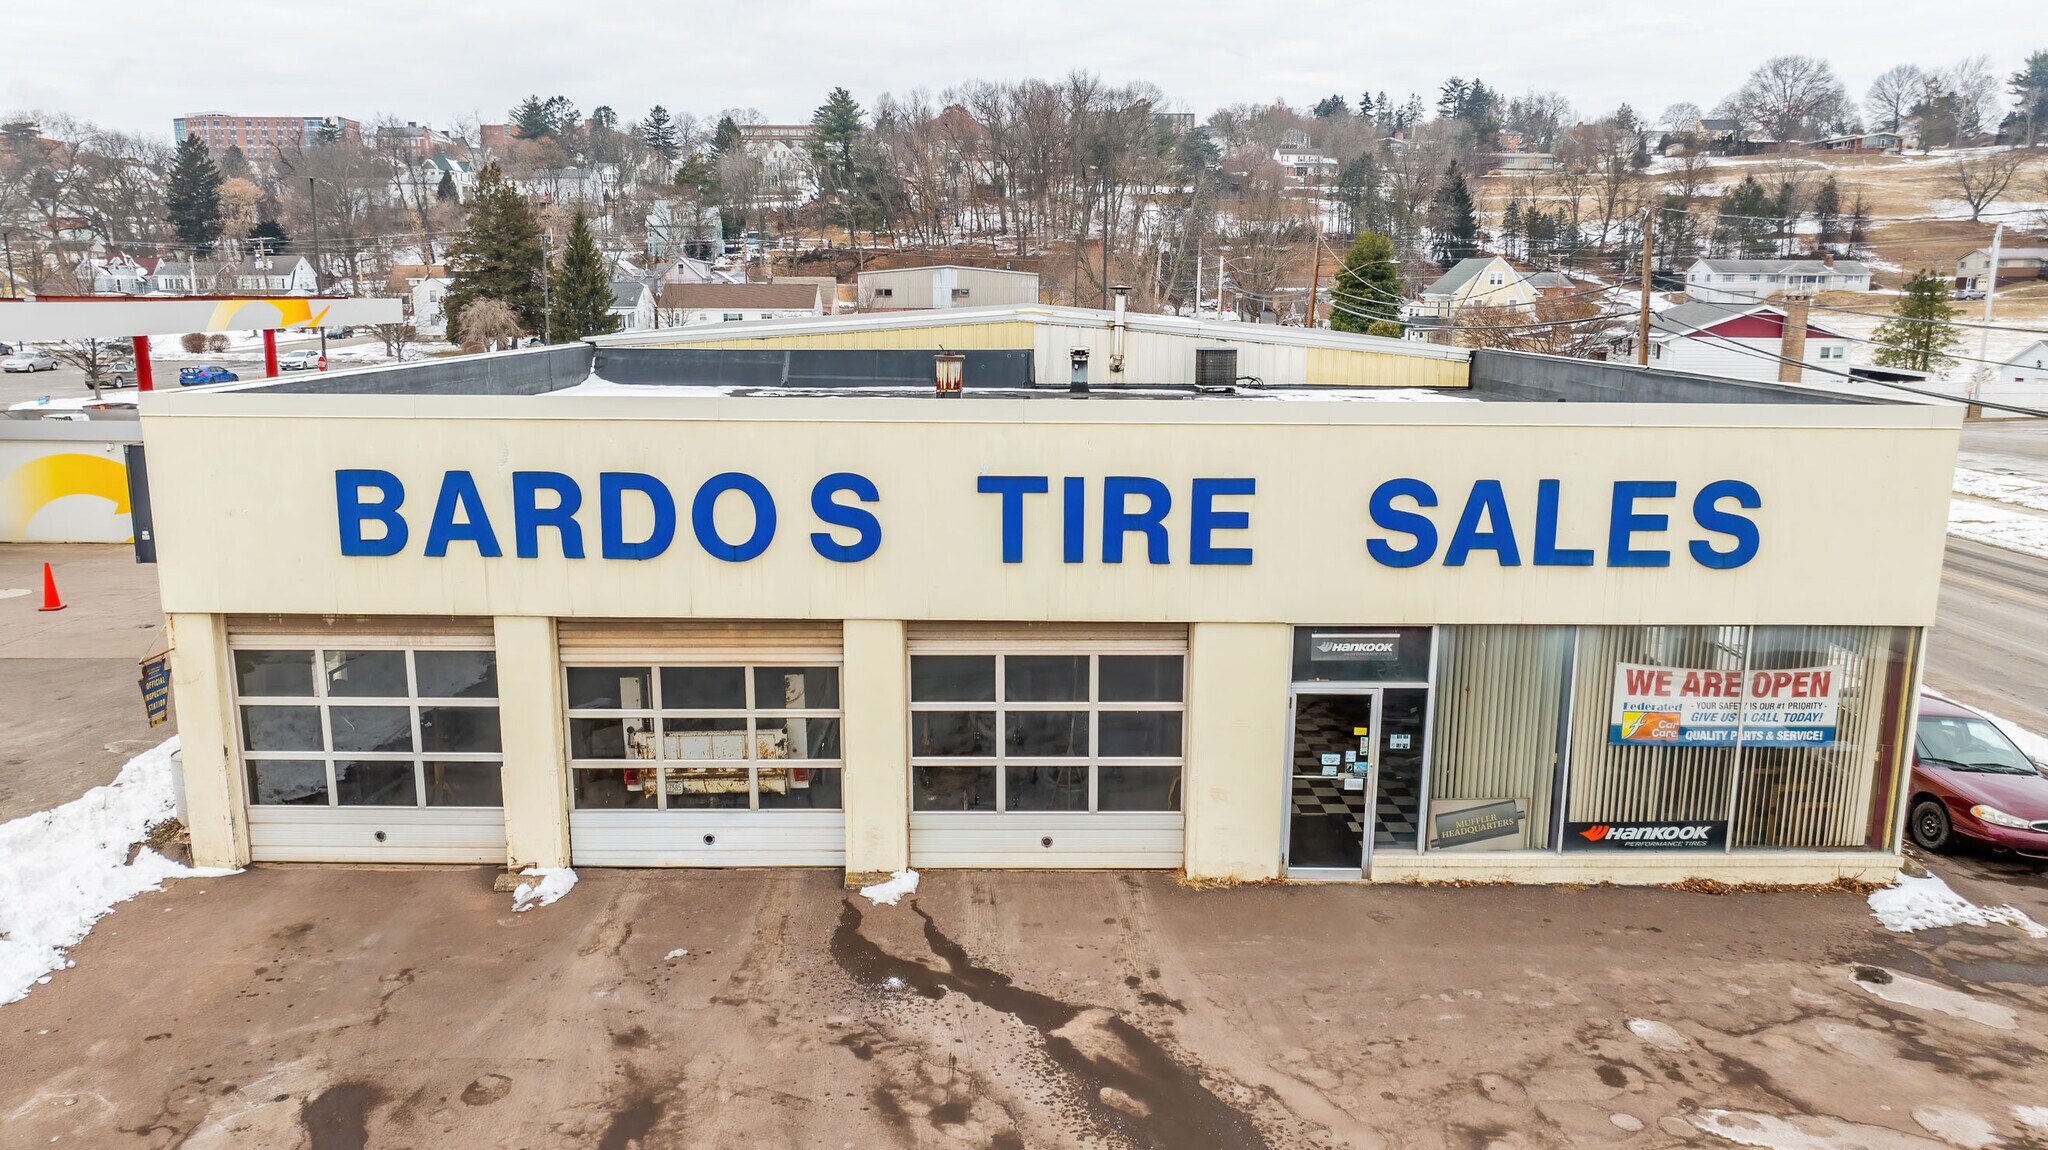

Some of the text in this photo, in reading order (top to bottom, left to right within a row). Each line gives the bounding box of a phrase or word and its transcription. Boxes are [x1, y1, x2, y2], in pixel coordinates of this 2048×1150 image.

[978, 476, 1255, 565] TIRE
[1367, 479, 1760, 568] SALES
[145, 676, 165, 690] OFFICIAL
[1626, 669, 1831, 698] WE ARE OPEN
[1623, 702, 1683, 711] Federated
[1696, 702, 1717, 710] YOUR
[1750, 702, 1758, 710] IS
[1760, 702, 1775, 710] OUR
[1776, 702, 1785, 710] #1
[1788, 702, 1823, 710] PRIORITY
[1691, 712, 1719, 722] GIVE
[1720, 712, 1737, 722] US
[1751, 712, 1779, 722] CALL
[1783, 712, 1824, 722] TODAY!
[1658, 720, 1680, 729] Car
[1651, 728, 1678, 737] Care
[1685, 731, 1728, 741] QUALITY
[1765, 731, 1775, 740] &
[1776, 730, 1823, 741] SERVICE!
[1455, 814, 1498, 828] MUFFLER
[1441, 818, 1514, 838] HEADQUARTERS
